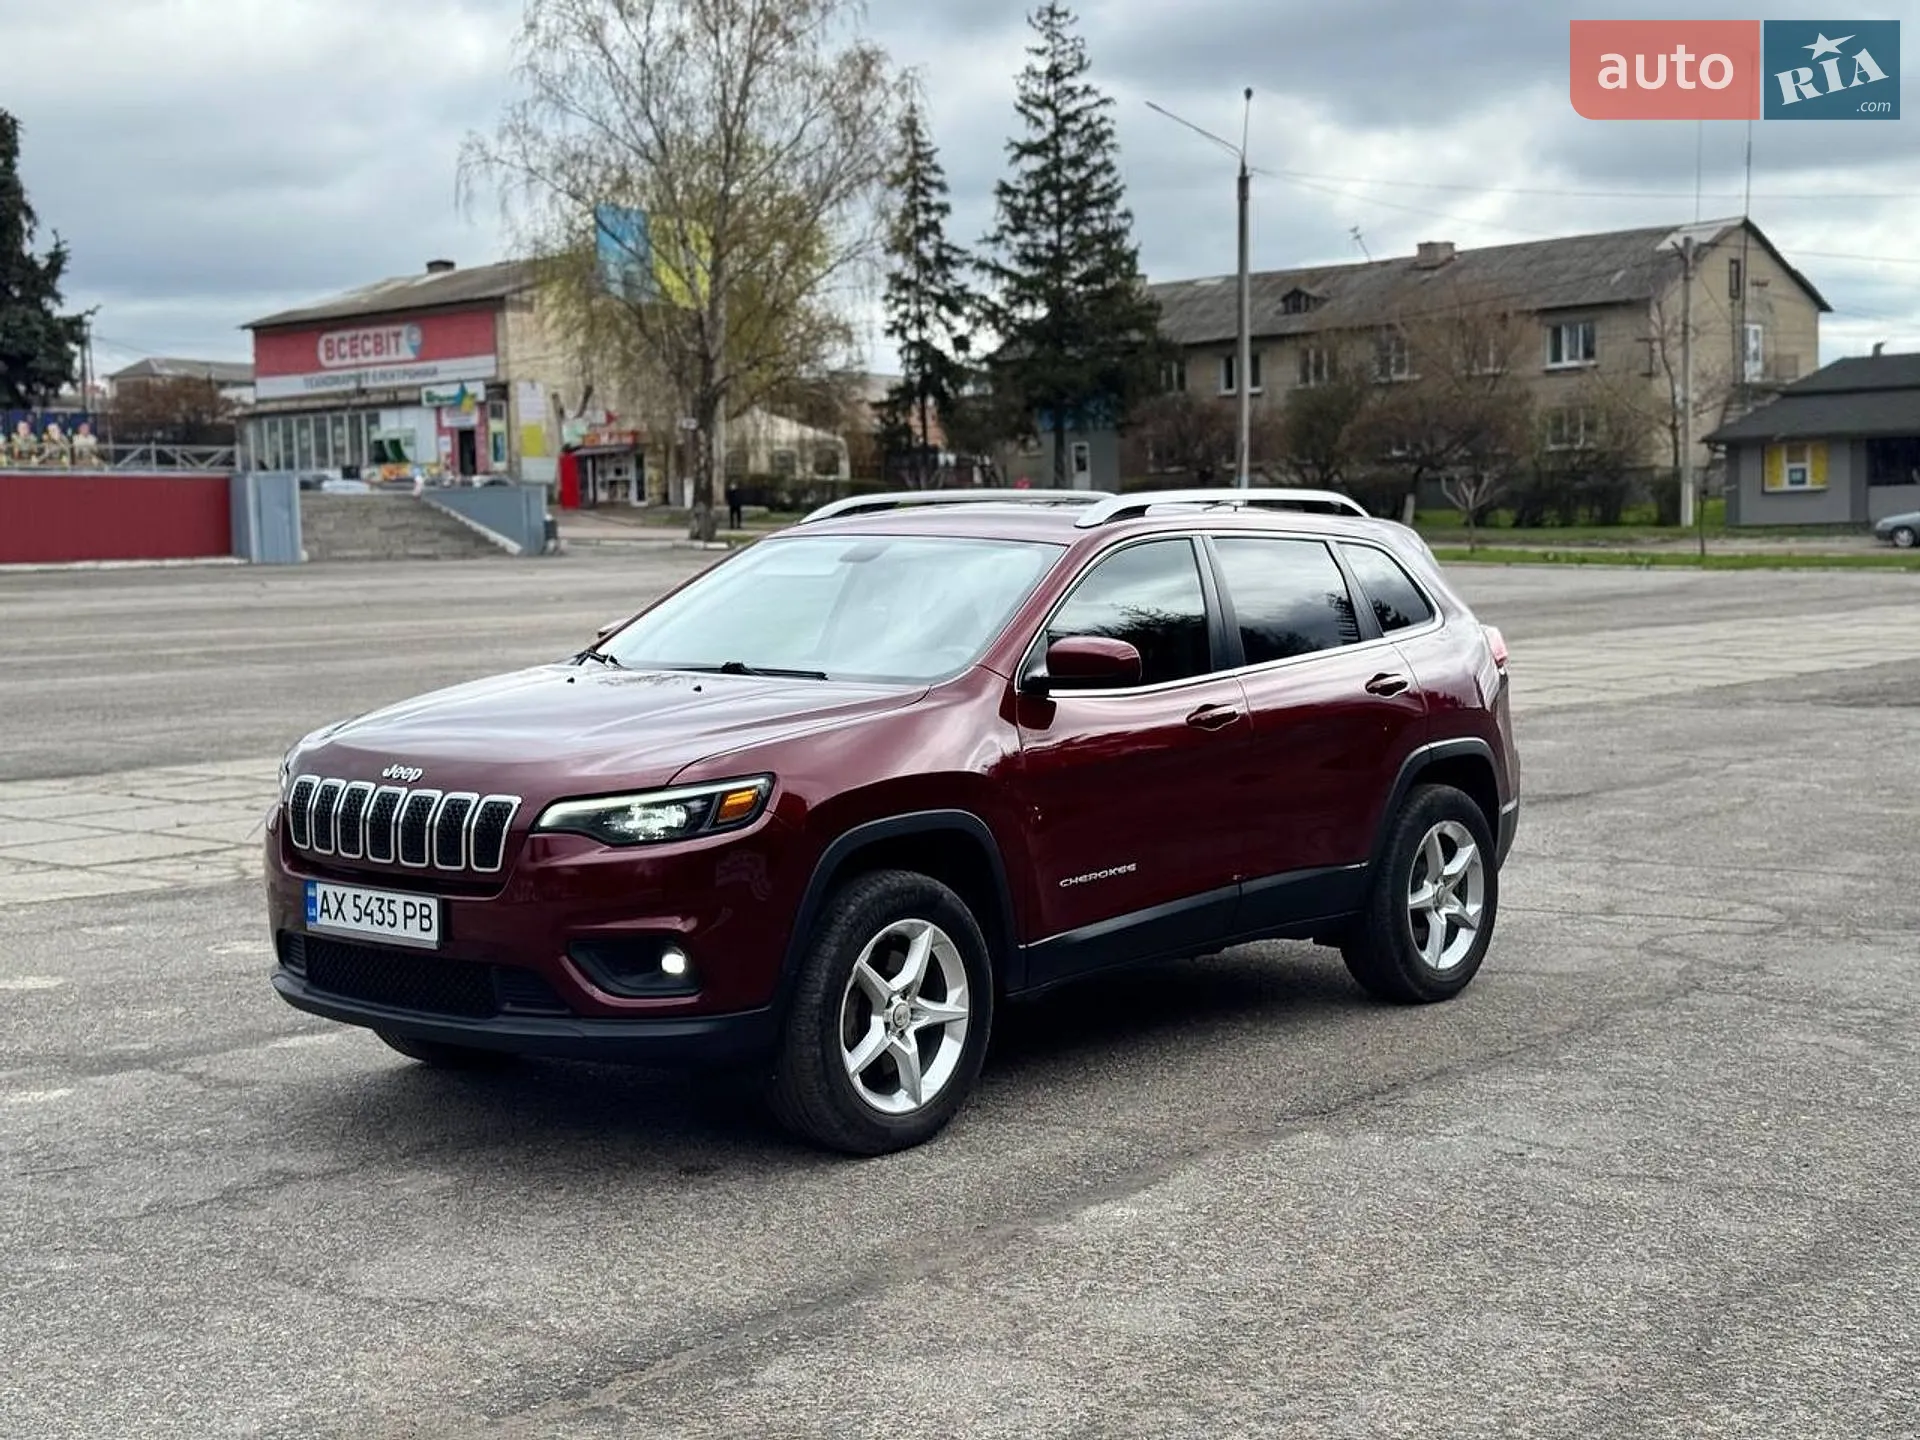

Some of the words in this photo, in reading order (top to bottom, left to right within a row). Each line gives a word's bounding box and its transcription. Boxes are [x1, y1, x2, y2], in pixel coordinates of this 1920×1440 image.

[324, 330, 402, 362] ВСЕСВІТ
[303, 371, 369, 389] ТЕХНОМАРКТ
[382, 764, 423, 783] Jeep
[1059, 863, 1137, 888] CHEROKEE
[319, 890, 347, 922] AX
[352, 894, 398, 929] 5435
[403, 901, 433, 932] PB
